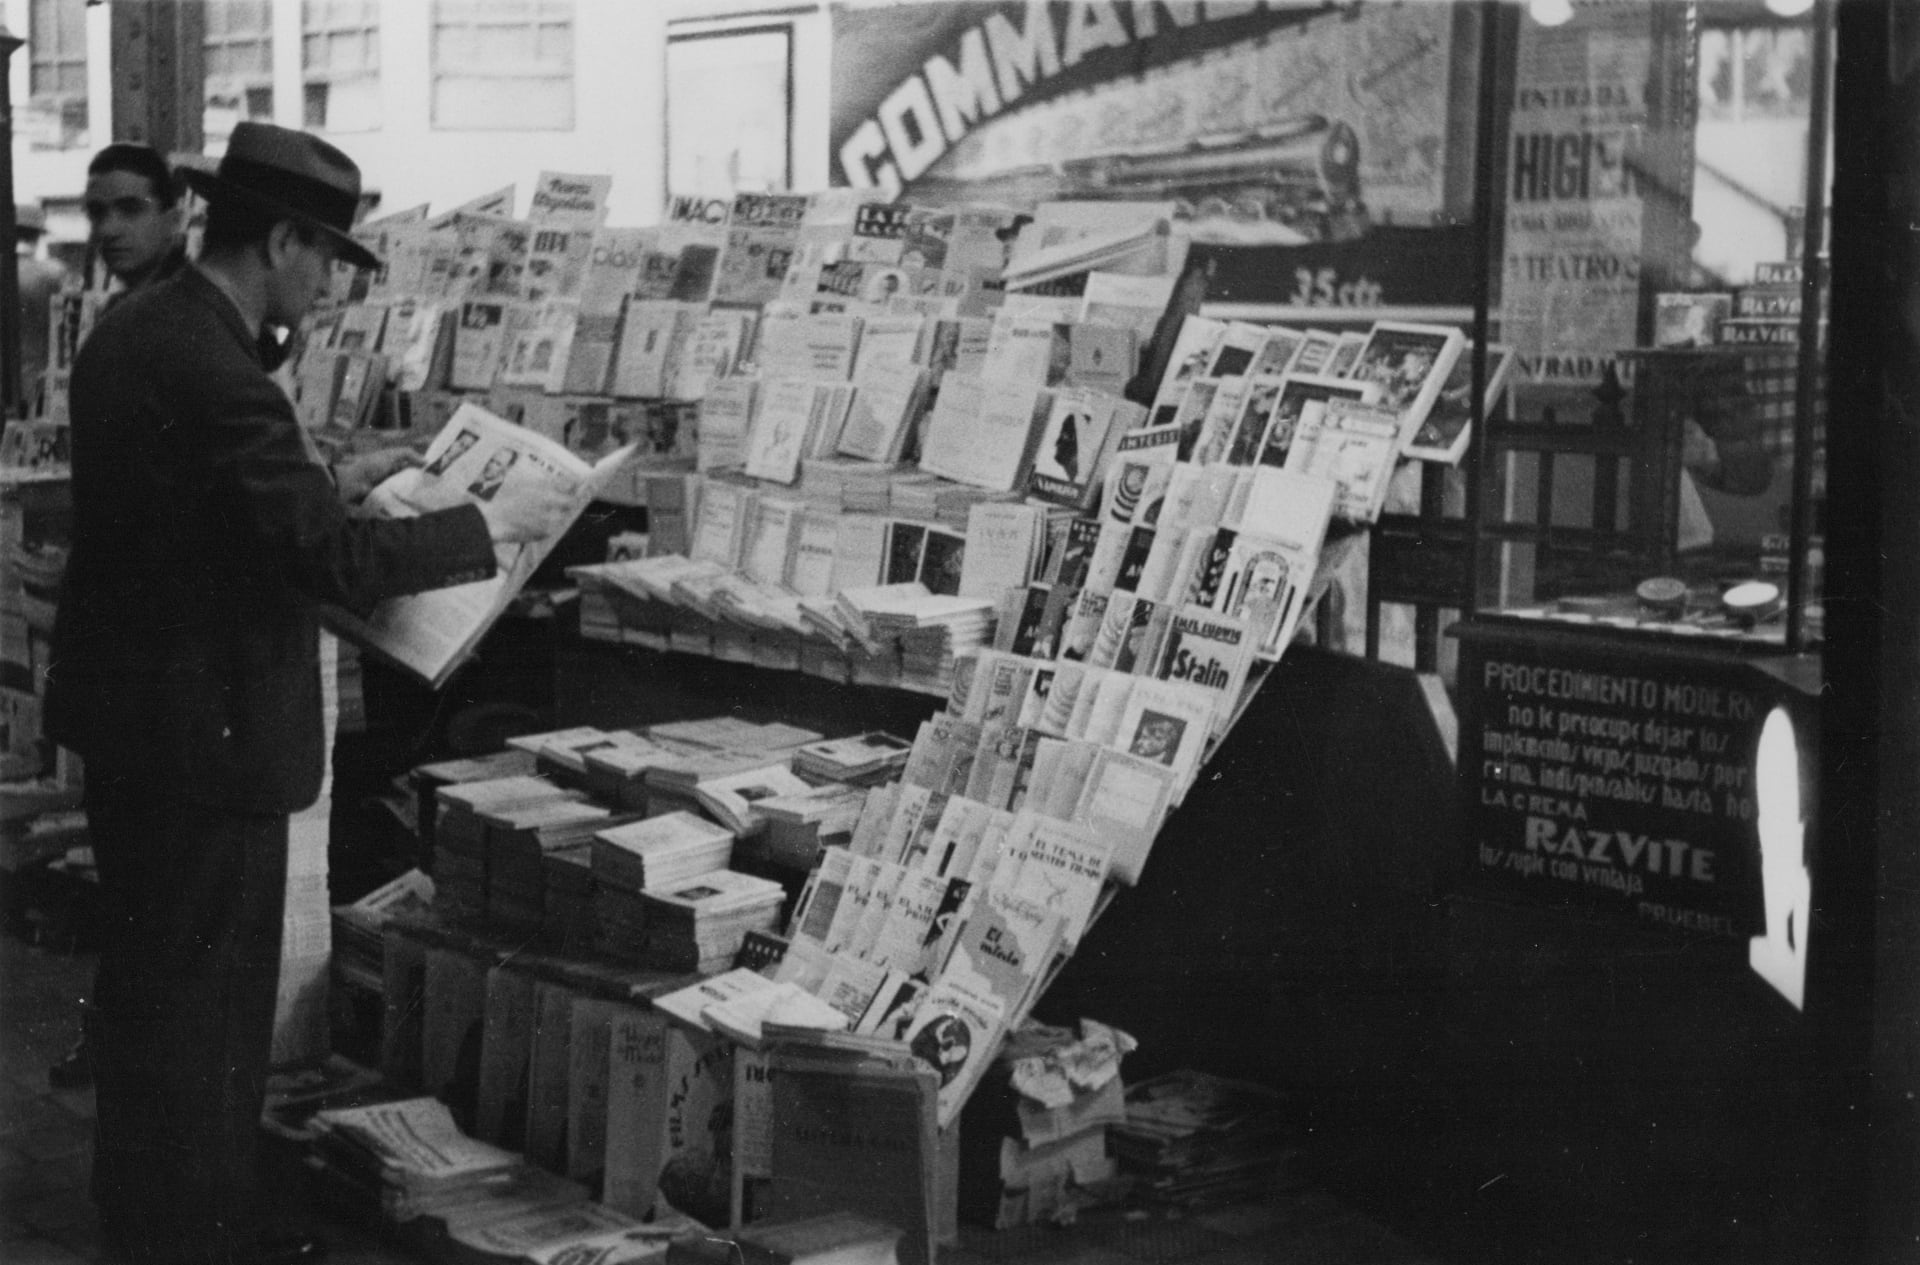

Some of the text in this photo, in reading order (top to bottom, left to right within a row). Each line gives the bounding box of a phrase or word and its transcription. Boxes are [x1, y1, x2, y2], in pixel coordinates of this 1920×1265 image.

[1172, 648, 1230, 692] Stalin
[1483, 660, 1758, 721] PROCEDIMIENTO MODERN
[1508, 703, 1534, 728] no
[1557, 710, 1640, 747] preocupe
[1643, 717, 1694, 751] dejar
[1481, 786, 1507, 807] LA
[1713, 763, 1744, 790] por
[1525, 814, 1717, 884] RAZVITE
[1550, 858, 1579, 883] con
[1582, 865, 1644, 897] ventaja
[986, 925, 1003, 943] El
